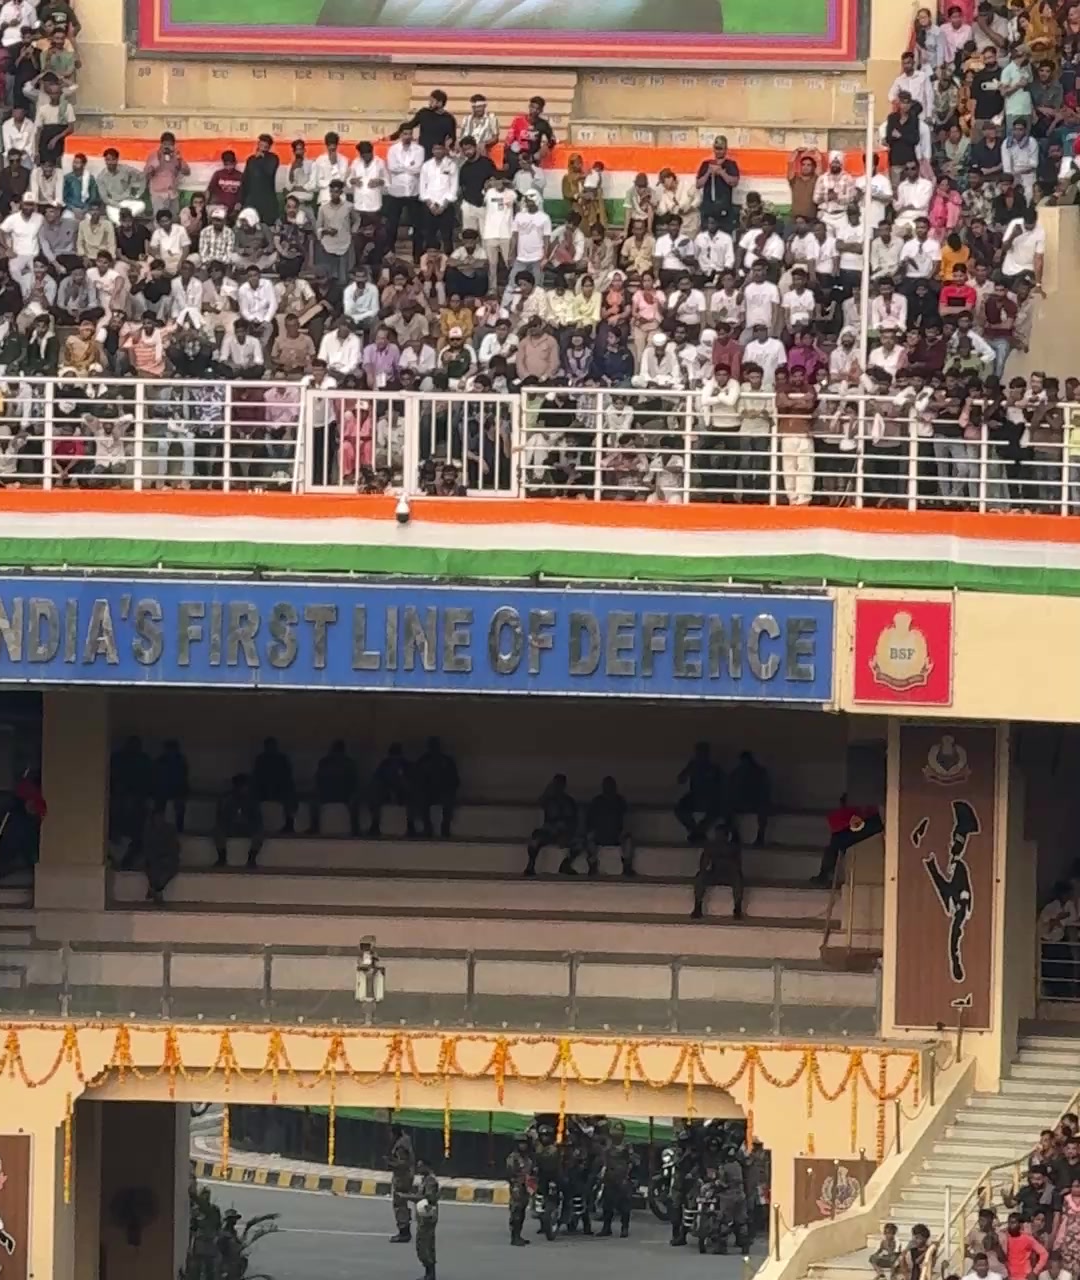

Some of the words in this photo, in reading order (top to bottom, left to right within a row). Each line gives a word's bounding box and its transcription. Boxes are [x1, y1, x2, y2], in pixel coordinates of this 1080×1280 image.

[177, 602, 337, 669] FIRST
[352, 604, 472, 672] LINE
[488, 606, 556, 675] OF
[567, 609, 817, 682] DEFENCE
[889, 647, 916, 660] BSF
